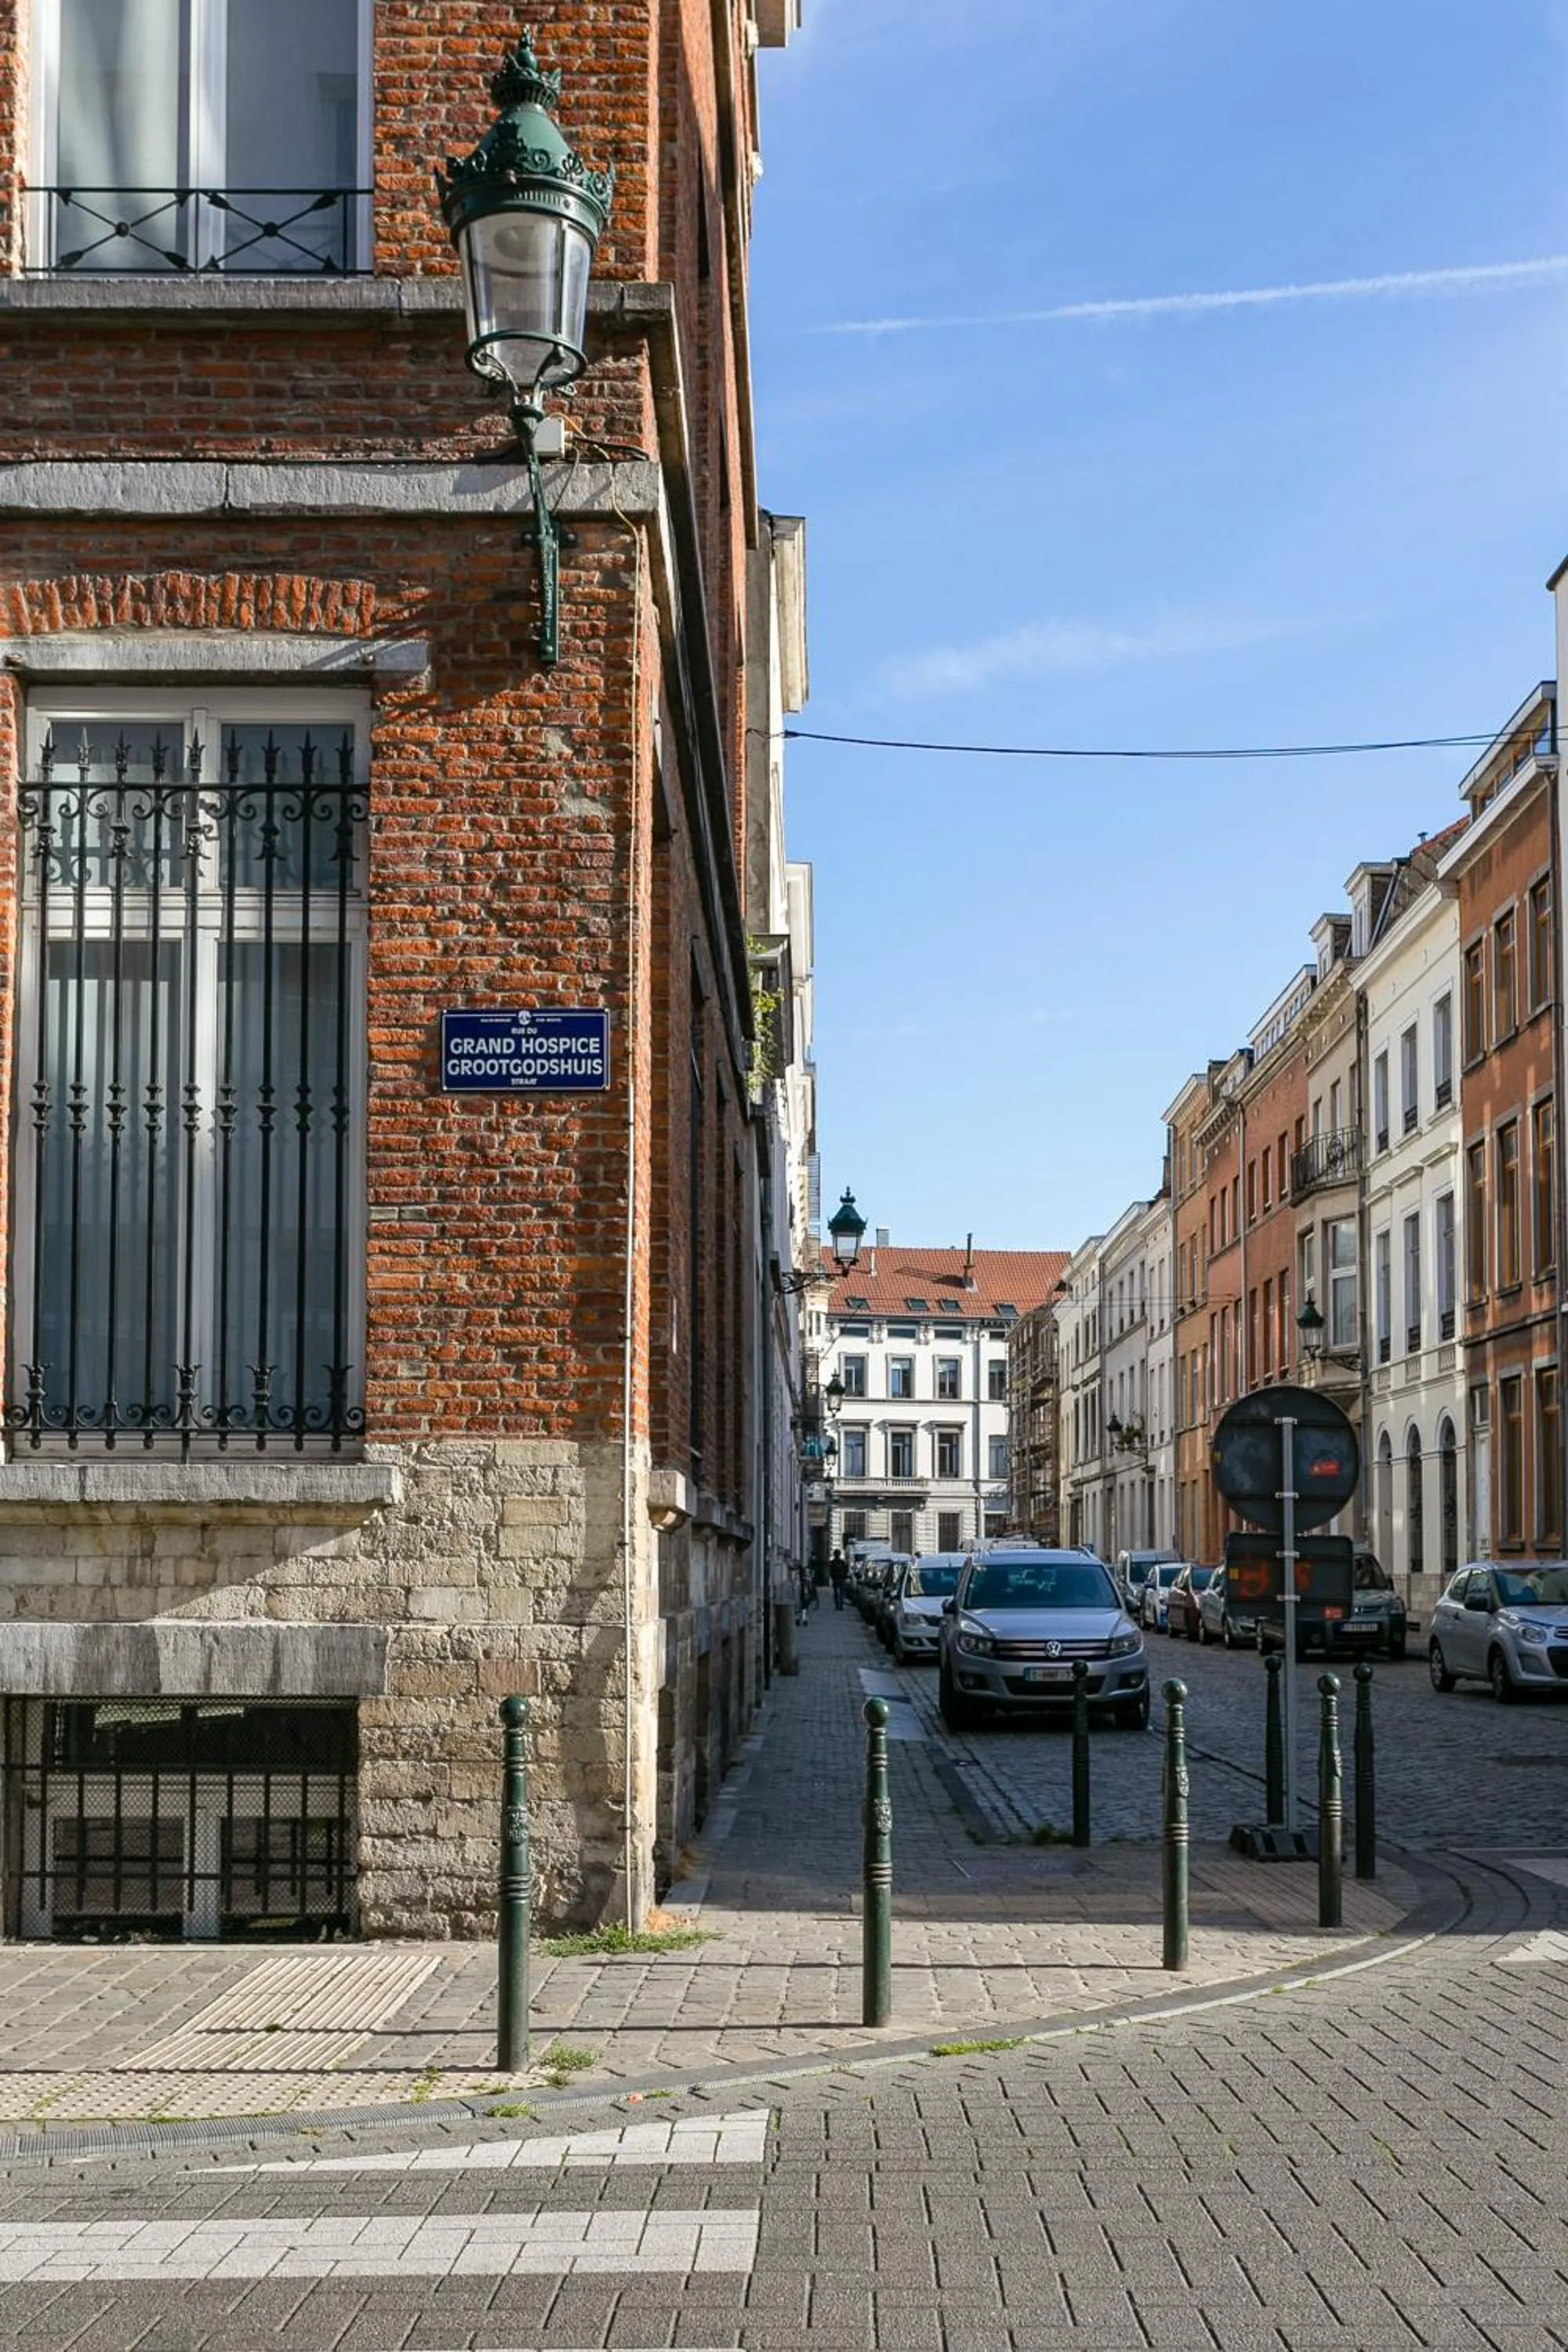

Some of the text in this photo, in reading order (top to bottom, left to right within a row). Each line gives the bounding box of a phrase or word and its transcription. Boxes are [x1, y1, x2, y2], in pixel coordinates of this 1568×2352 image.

[450, 1037, 601, 1054] GRAND HOSPICE
[447, 1058, 603, 1076] GROOTGODSHUIS
